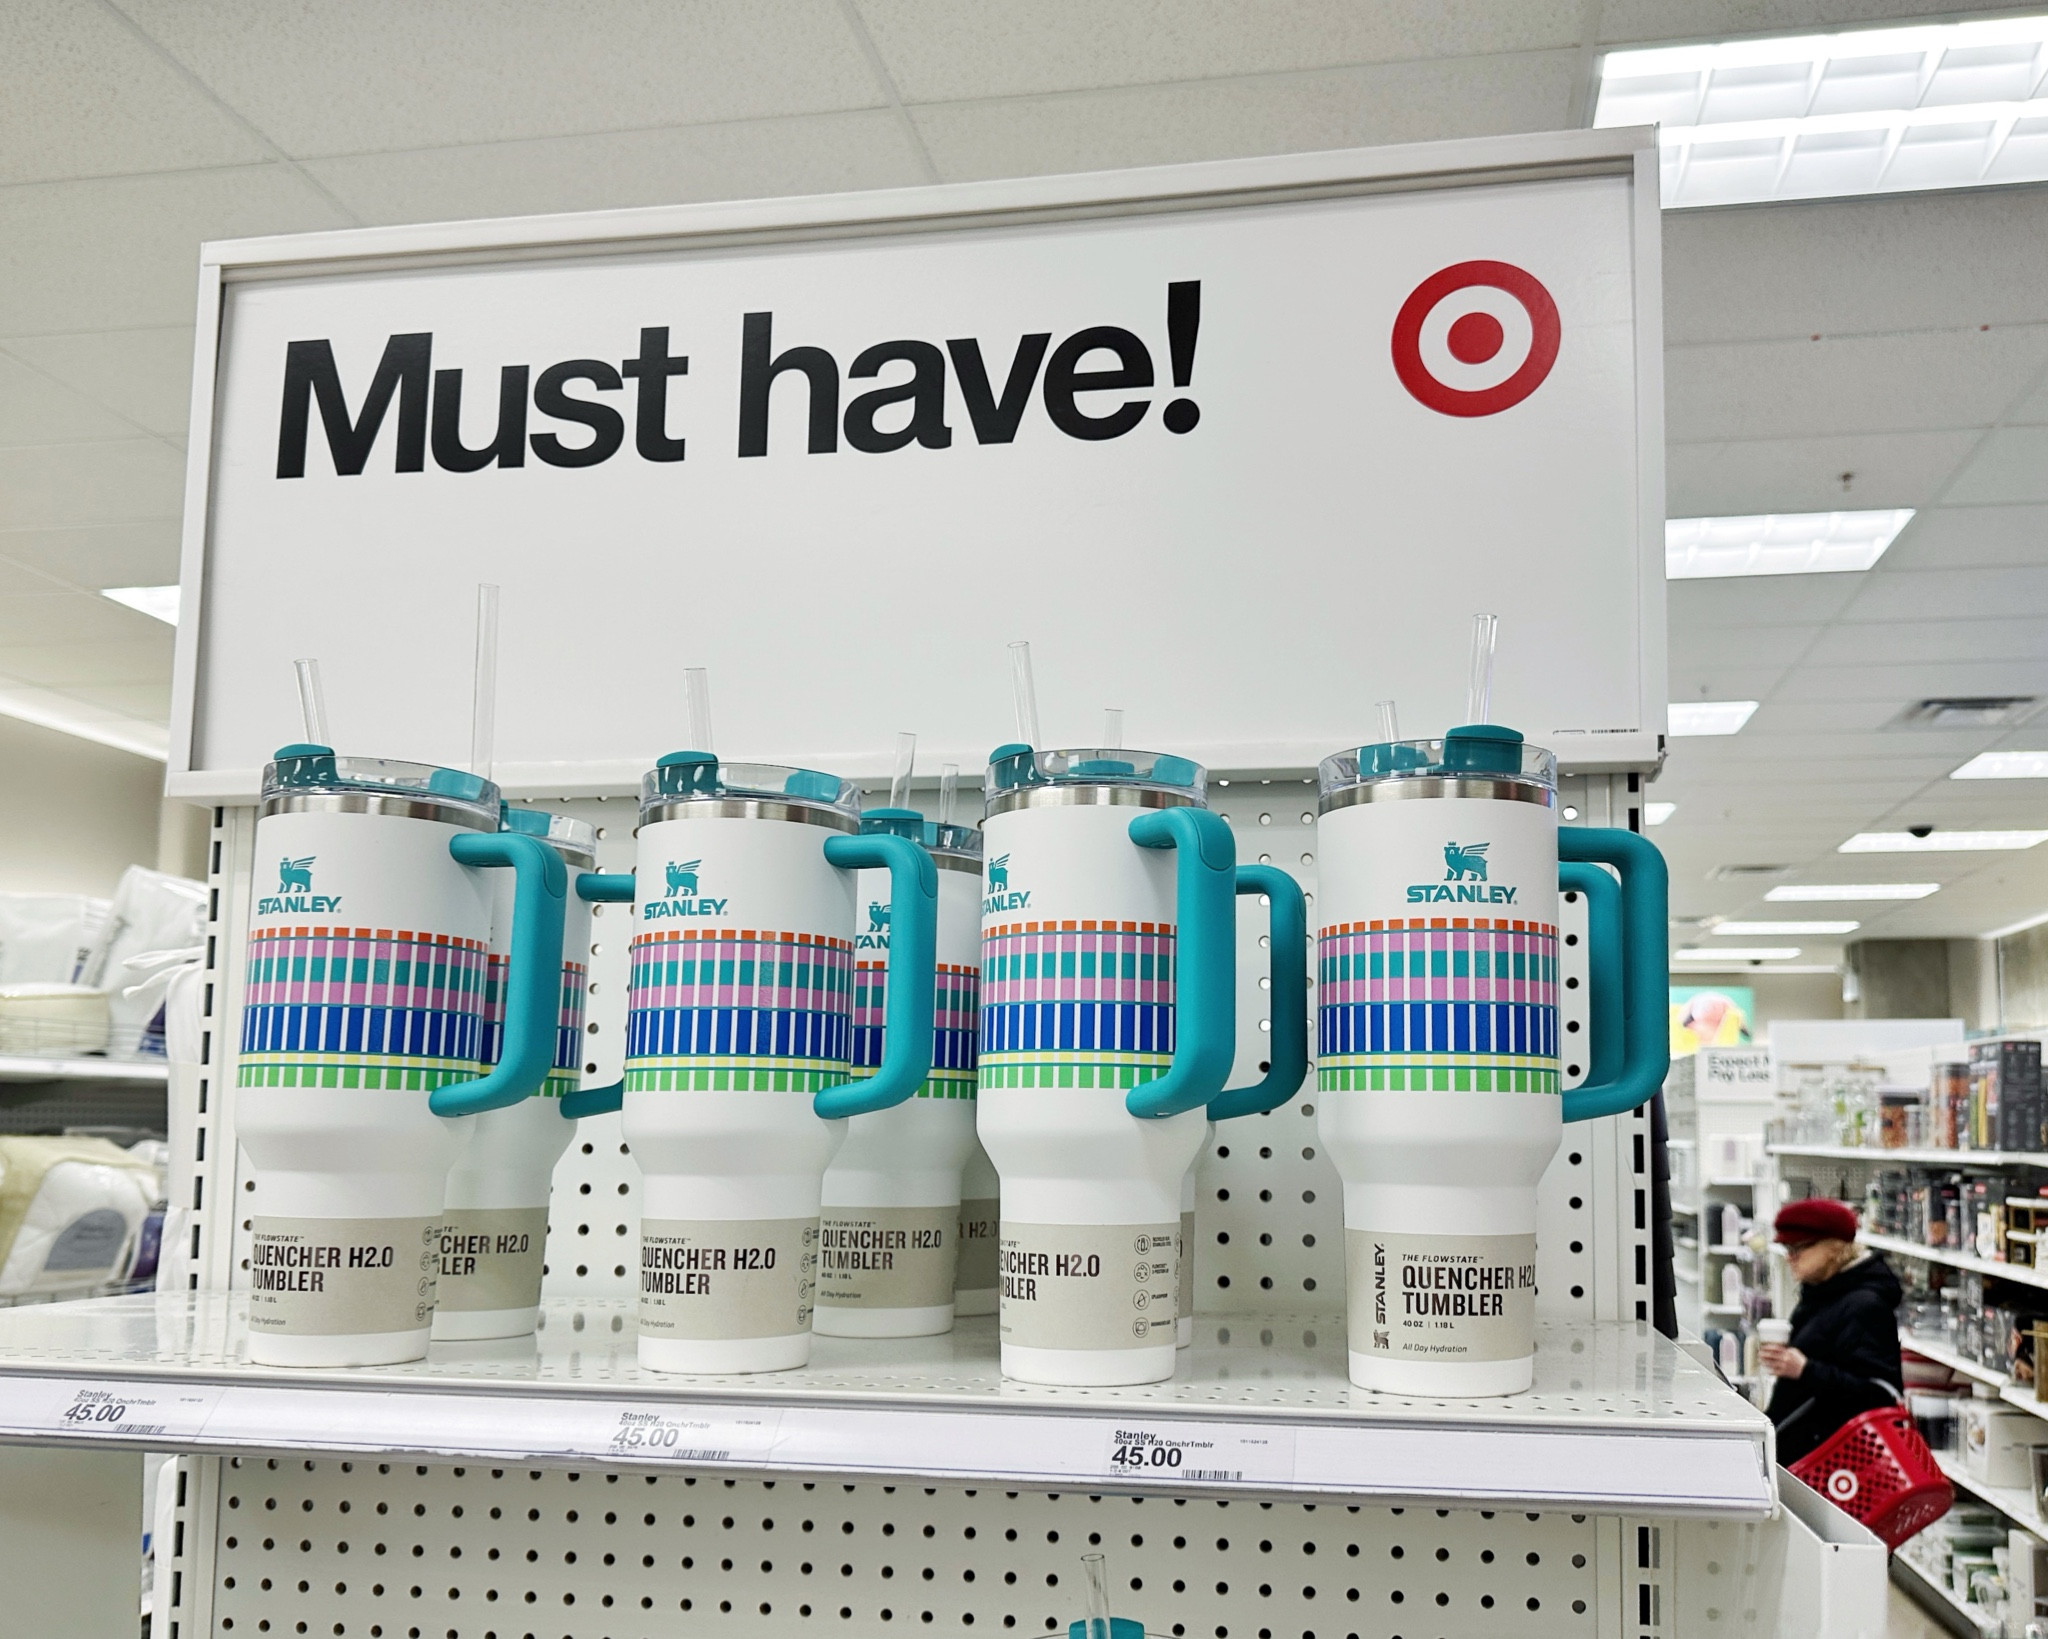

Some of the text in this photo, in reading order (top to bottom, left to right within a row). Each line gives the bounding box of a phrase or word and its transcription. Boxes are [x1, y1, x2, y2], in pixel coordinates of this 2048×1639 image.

[276, 280, 1201, 479] Must have!
[1406, 884, 1517, 904] STANLEY
[258, 896, 342, 915] STANLEY
[644, 899, 728, 920] STANLEY
[440, 1233, 529, 1254] CHER H2.0
[822, 1228, 906, 1250] QUENCHER
[911, 1230, 942, 1249] H2.0
[253, 1243, 394, 1268] QUENCHER H2.0
[641, 1246, 776, 1270] QUENCHER H2.0
[822, 1250, 893, 1270] TUMBLER
[1000, 1249, 1100, 1277] ENCHER H2.0
[1402, 1253, 1479, 1264] THE FLOWSTATE
[252, 1267, 324, 1293] TUMBLER
[641, 1270, 710, 1295] TUMBLER
[1374, 1243, 1386, 1325] STANLEY
[1402, 1265, 1515, 1290] QUENCHER
[1402, 1291, 1504, 1316] TUMBLER
[1403, 1320, 1412, 1328] 40
[1414, 1343, 1428, 1353] Day
[1430, 1344, 1468, 1354] Hydration
[77, 1389, 113, 1400] Stanley
[64, 1402, 126, 1422] 45.00
[620, 1411, 660, 1422] Stanley
[612, 1426, 680, 1448] 45.00
[1113, 1438, 1132, 1446] 40oz
[1114, 1429, 1157, 1442] Stanley
[1111, 1445, 1183, 1468] 45.00
